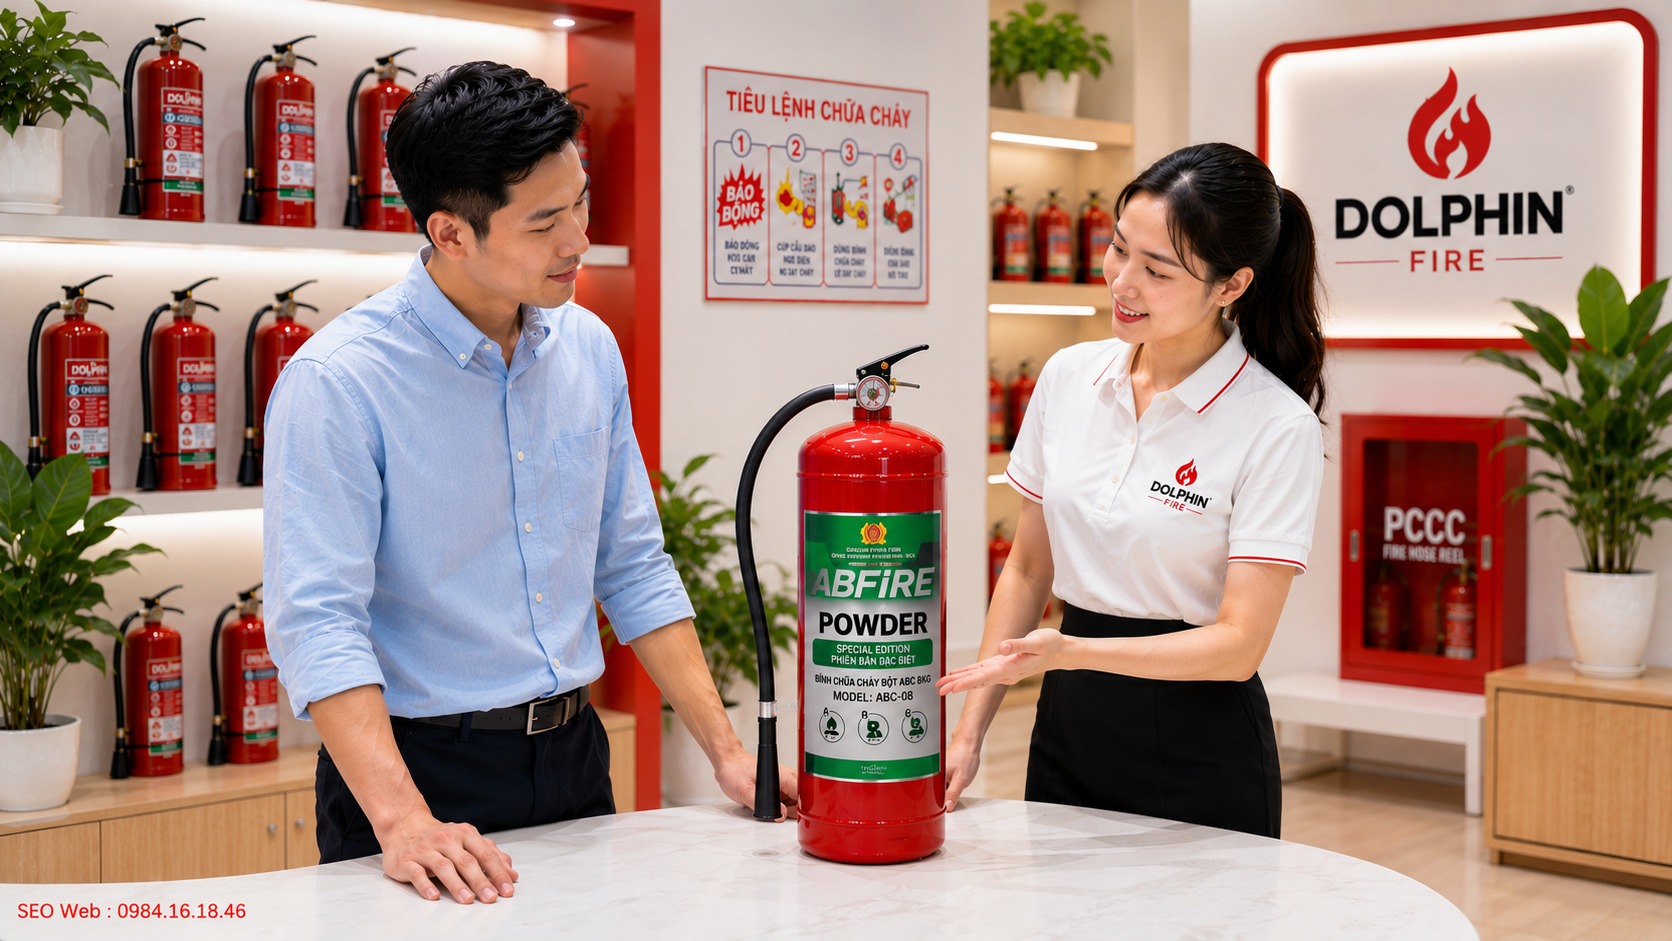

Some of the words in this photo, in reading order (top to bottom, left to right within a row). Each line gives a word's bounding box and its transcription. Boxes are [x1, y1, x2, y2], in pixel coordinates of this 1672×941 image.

[726, 86, 766, 114] TIÊU
[771, 91, 815, 122] LỆNH
[820, 99, 866, 124] CHỮA
[870, 103, 912, 129] CHÁY
[737, 135, 744, 152] 1
[791, 140, 801, 157] 2
[845, 144, 854, 161] 3
[893, 149, 902, 165] 4
[726, 180, 755, 202] BÁO
[1410, 249, 1485, 272] FIRE
[1150, 480, 1209, 509] DOLPHIN
[1163, 498, 1186, 511] FIRE
[1384, 506, 1466, 546] PCCC
[819, 612, 928, 636] POWDER
[836, 644, 873, 655] SPECIAL
[875, 644, 911, 654] EDITION
[899, 677, 916, 687] ABC
[833, 690, 873, 703] MODEL:
